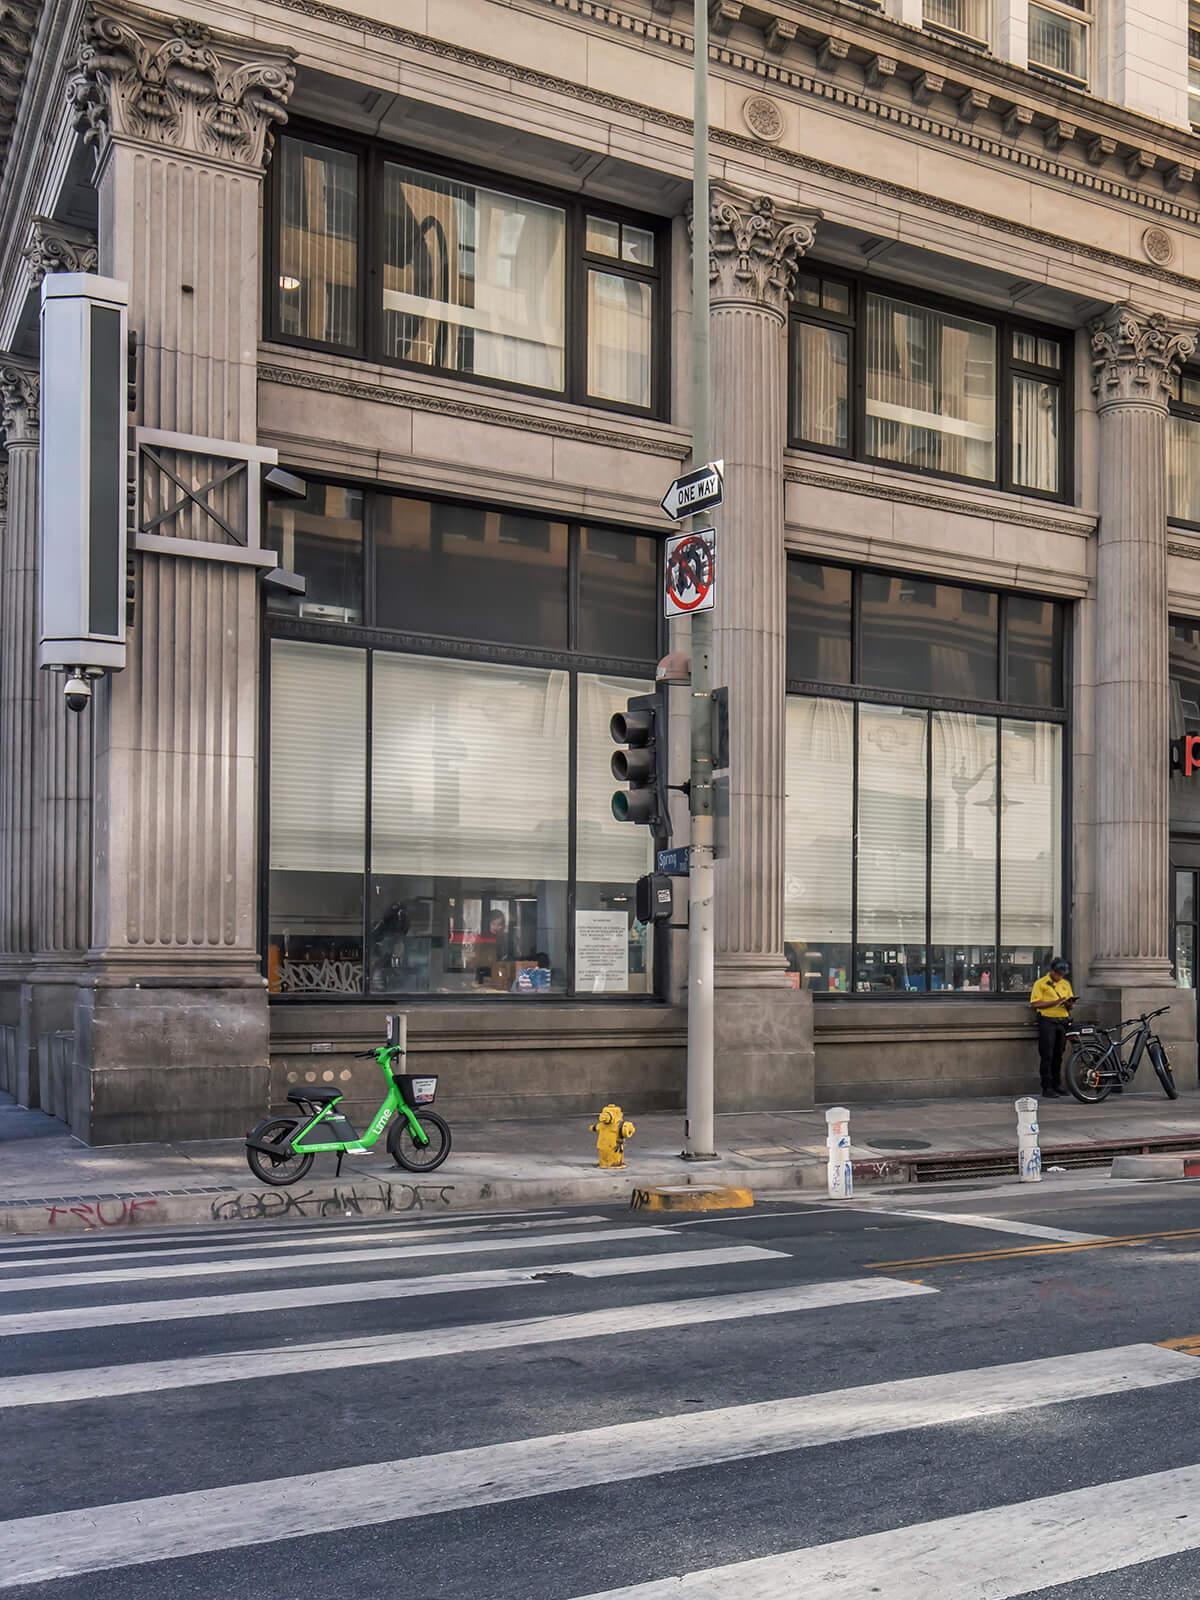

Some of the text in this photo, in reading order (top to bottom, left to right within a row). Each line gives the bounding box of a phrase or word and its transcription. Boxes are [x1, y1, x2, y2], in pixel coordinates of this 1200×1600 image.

[678, 477, 715, 505] ONE WAY
[658, 853, 677, 870] Spring
